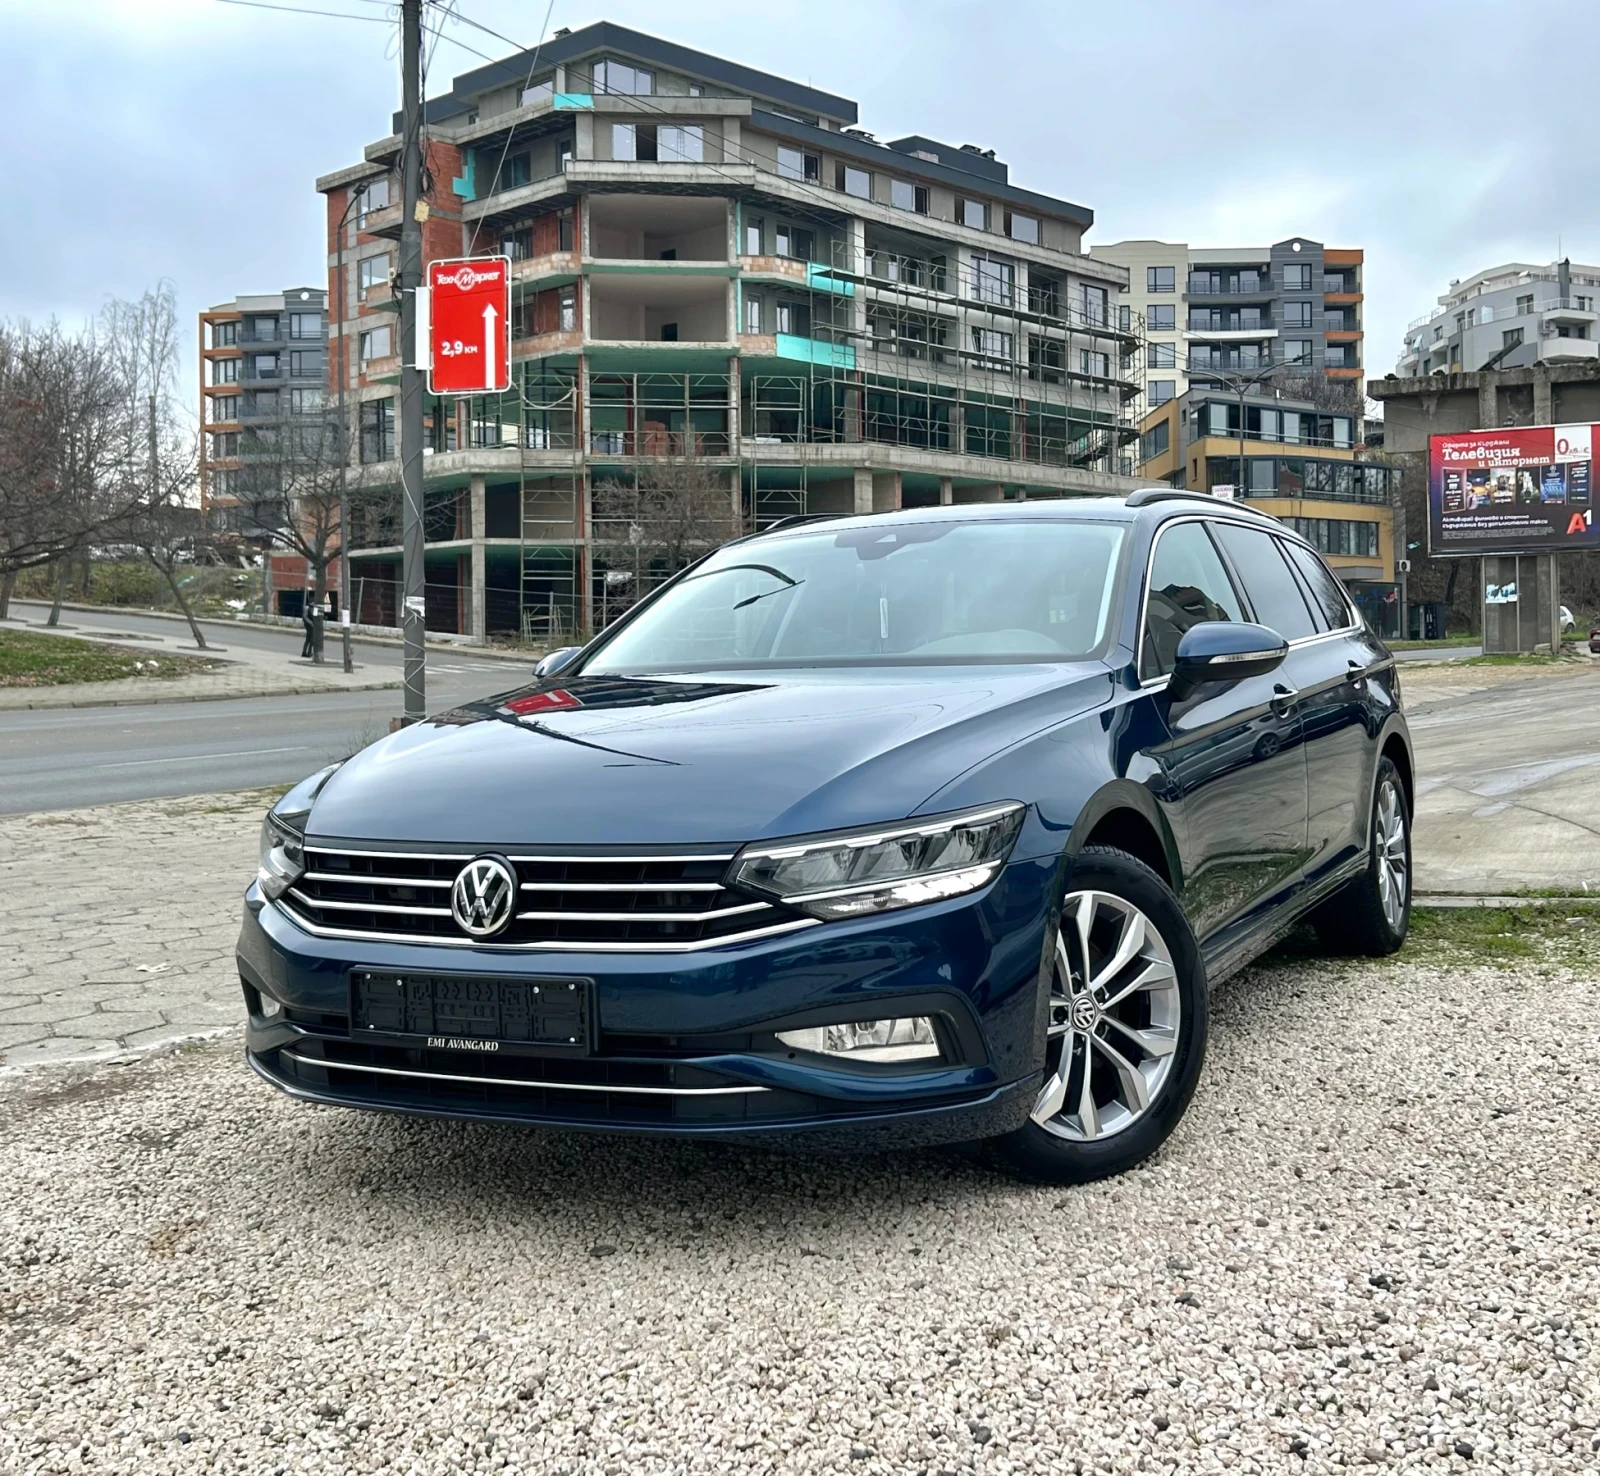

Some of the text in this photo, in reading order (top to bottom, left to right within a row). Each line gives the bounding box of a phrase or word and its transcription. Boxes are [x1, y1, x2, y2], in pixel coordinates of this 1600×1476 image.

[441, 341, 478, 358] 2,9 км
[1477, 439, 1510, 448] Кърджали
[1442, 447, 1521, 461] Телевизия
[1488, 457, 1550, 467] интернет
[1566, 509, 1592, 535] A1
[427, 1037, 499, 1051] EMI AVANGARD
